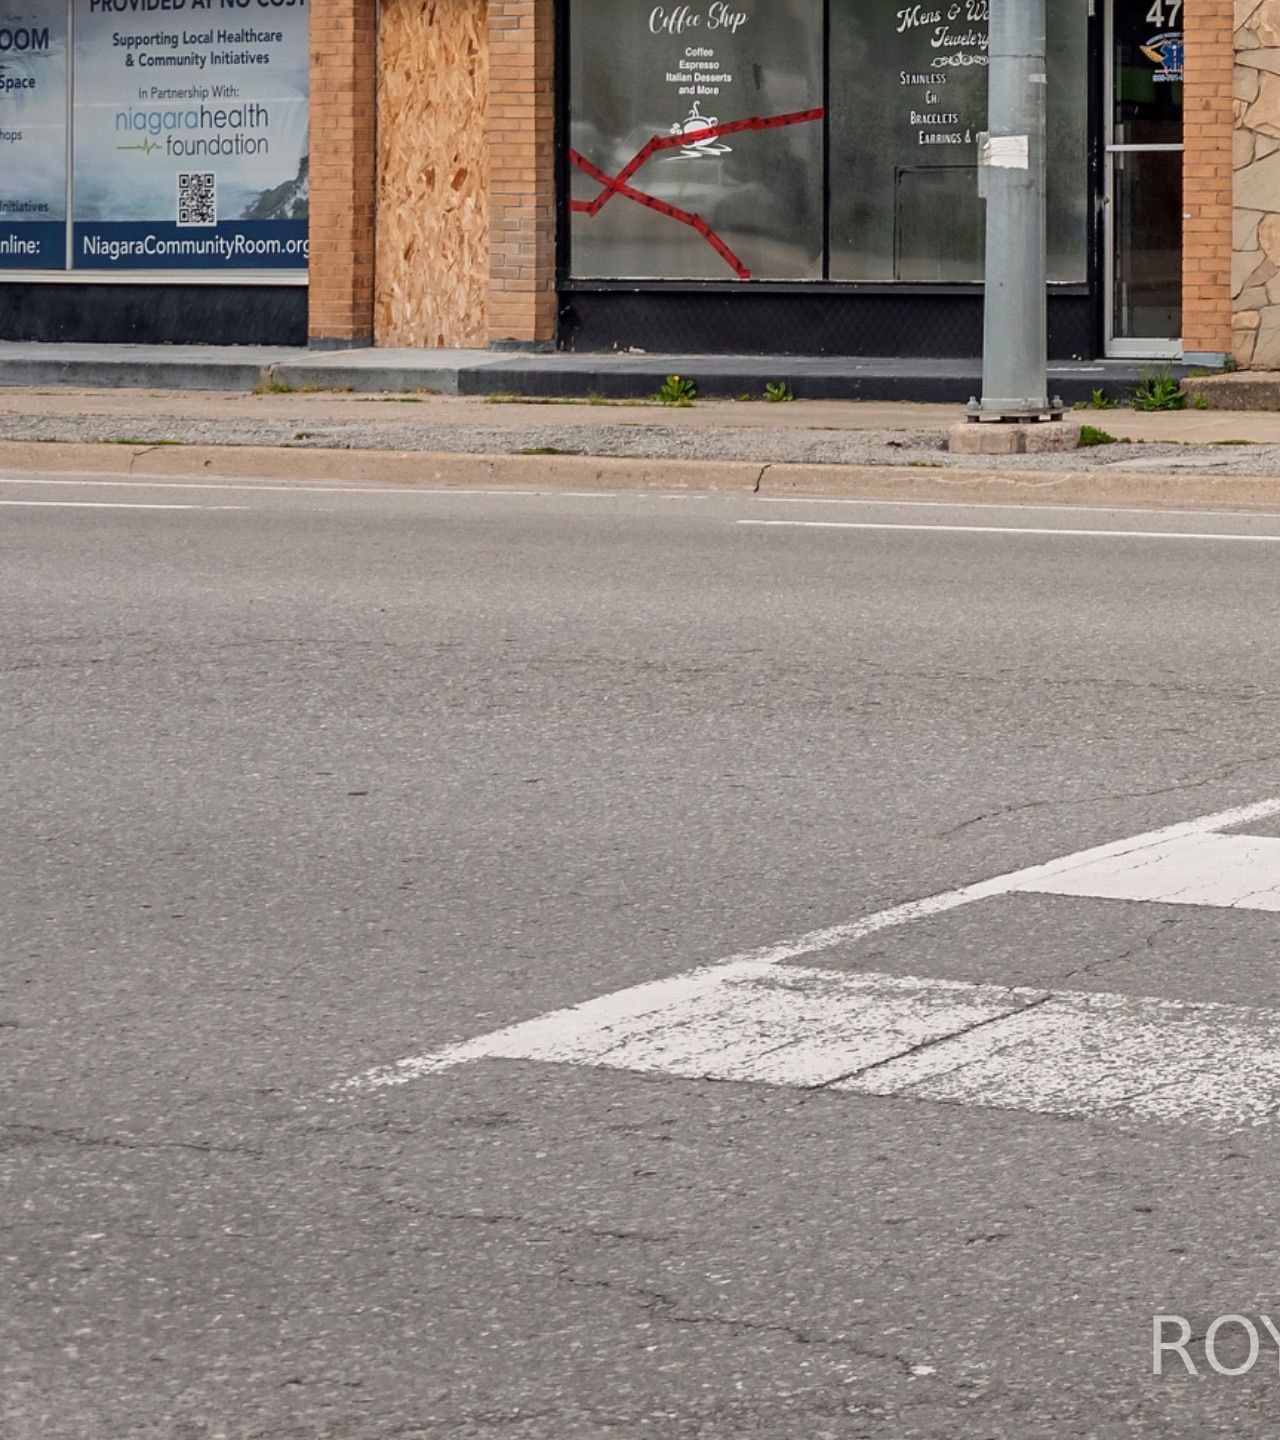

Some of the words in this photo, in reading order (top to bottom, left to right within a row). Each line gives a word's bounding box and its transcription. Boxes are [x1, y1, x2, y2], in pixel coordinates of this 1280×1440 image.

[896, 4, 941, 32] Mens
[947, 2, 961, 20] &
[113, 31, 179, 48] Supporting
[183, 29, 213, 45] Local
[217, 28, 283, 43] Healthcare
[125, 53, 134, 67] &
[138, 51, 207, 69] Community
[210, 50, 270, 65] Initiatives
[685, 47, 714, 57] Coffee
[679, 60, 720, 71] Espresso
[665, 72, 692, 82] Italian
[694, 72, 733, 82] Desserts
[900, 70, 947, 85] STAINLESS
[138, 87, 147, 99] In
[151, 85, 209, 100] Partnership
[212, 85, 240, 98] With:
[679, 85, 695, 95] and
[697, 85, 719, 95] More
[166, 133, 269, 156] foundation
[0, 234, 40, 254] nline:
